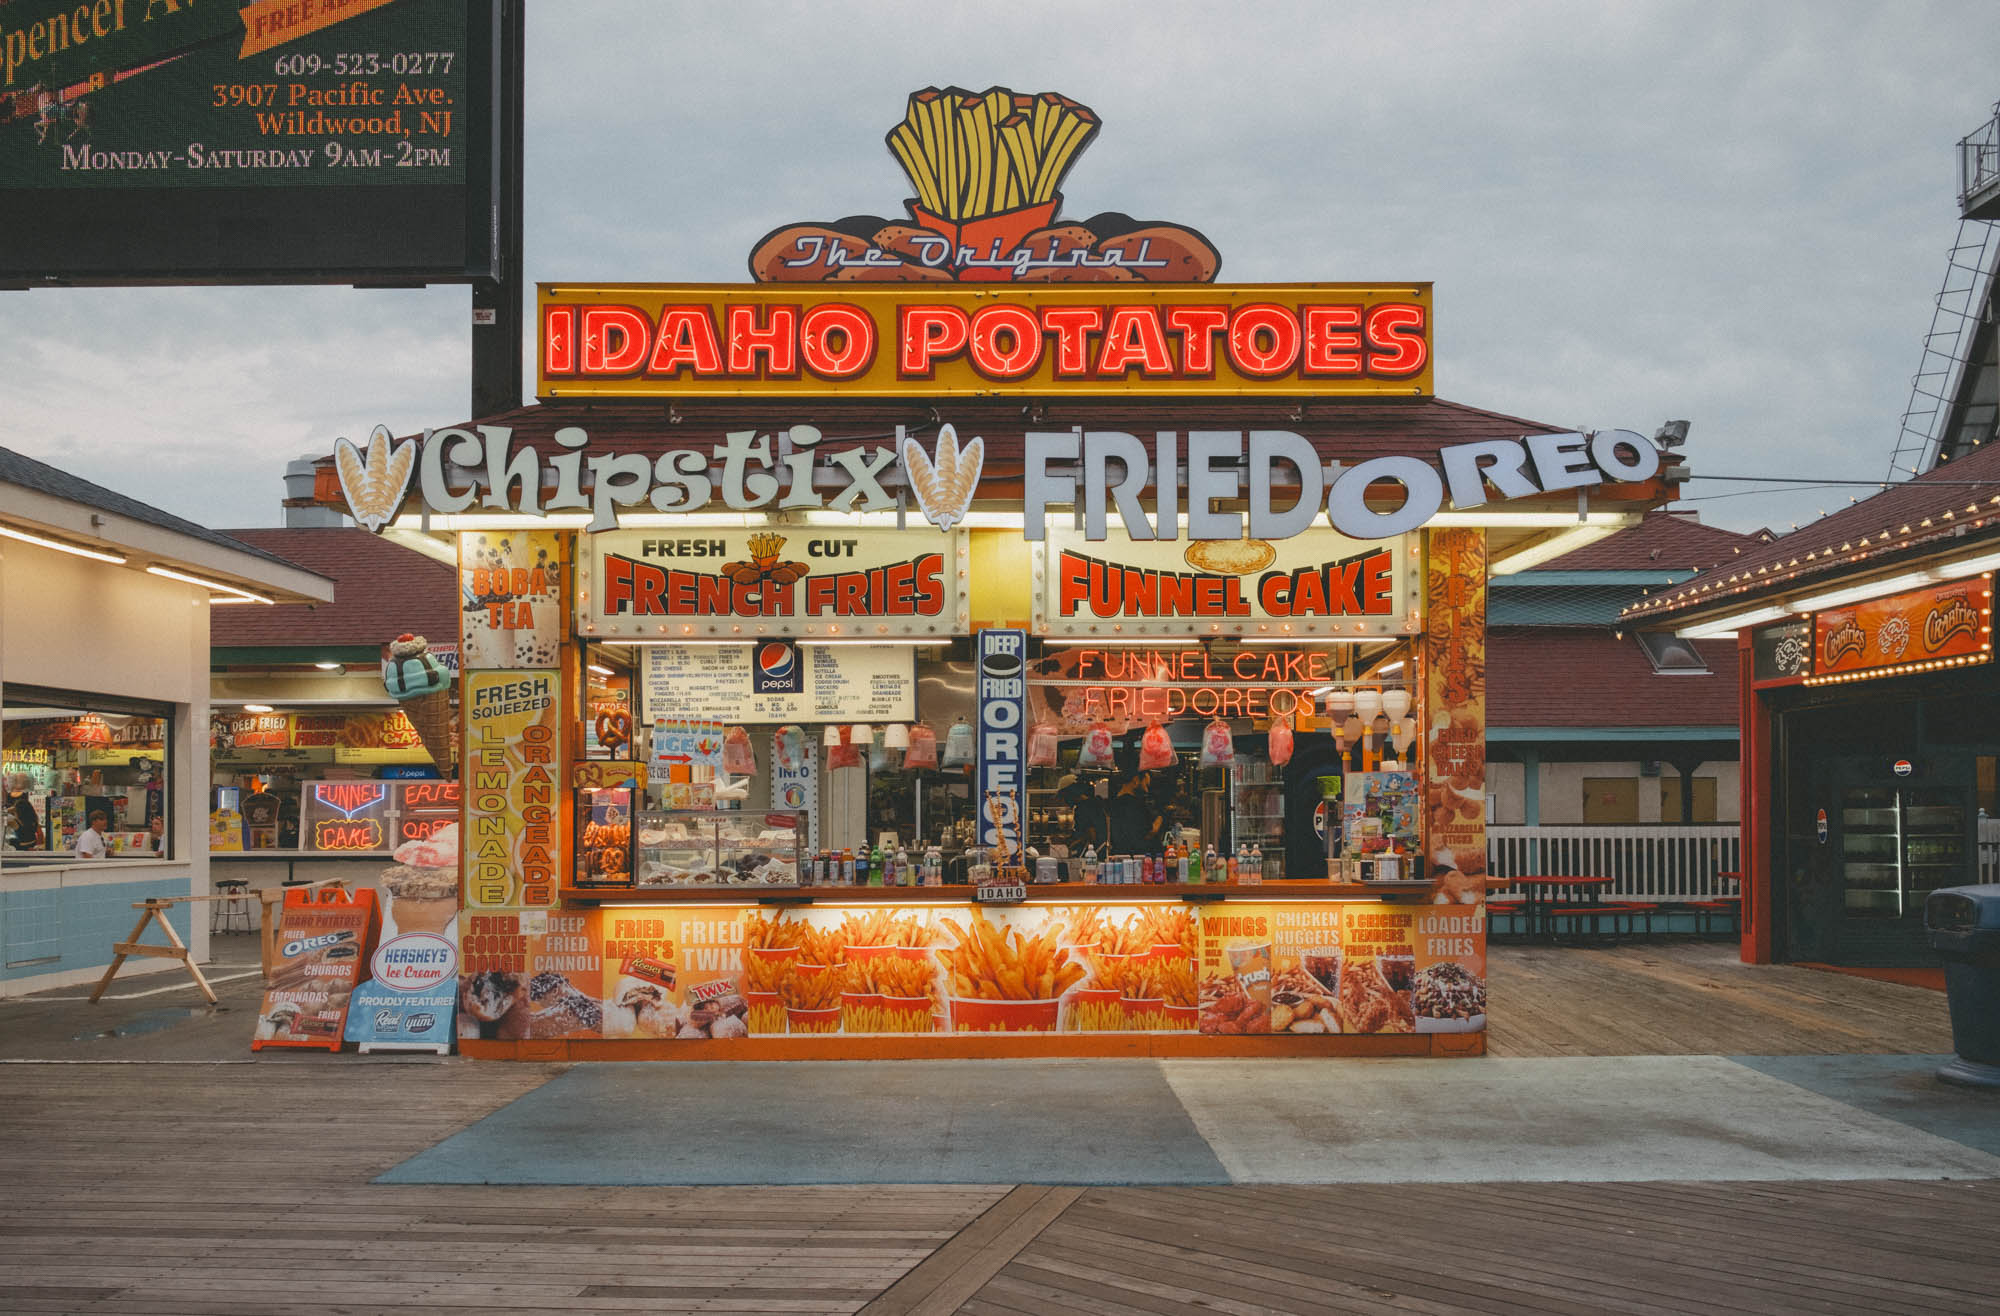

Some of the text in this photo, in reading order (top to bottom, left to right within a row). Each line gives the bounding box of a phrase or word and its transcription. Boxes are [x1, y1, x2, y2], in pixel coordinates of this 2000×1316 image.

[254, 0, 315, 40] FREE
[0, 0, 126, 87] pencer
[275, 52, 455, 76] 609-523-0277
[212, 81, 454, 107] 3907 Pacific Ave.
[256, 110, 453, 137] Wildwood, NJ
[783, 236, 1168, 275] The Original
[544, 303, 1429, 380] IDAHO POTATOES
[420, 424, 900, 533] Chipstix
[1023, 428, 1661, 542] FRIED OREO
[641, 539, 859, 558] FRESH CUT
[473, 568, 548, 597] BOBA
[602, 551, 946, 617] FRENCH FRIES
[1058, 545, 1394, 618] FUNNEL CAKE
[486, 602, 535, 630] TEA
[984, 634, 1020, 655] DEEP
[1079, 650, 1331, 682] FUNNEL CAKE
[475, 677, 550, 706] FRESH
[761, 678, 793, 690] pepsi
[982, 678, 1022, 699] FRIED
[472, 697, 552, 720] SQUEEZED
[232, 717, 287, 732] DEEP FRIED
[655, 718, 724, 736] SHAVED
[655, 736, 695, 752] ICE
[317, 784, 383, 812] FUNNEL
[475, 725, 509, 905] LEMONADE
[521, 724, 553, 906] ORANGEADE
[323, 827, 375, 848] CAKE
[981, 887, 1023, 899] IDAHO
[470, 916, 520, 935] FRIED
[549, 916, 586, 933] DEEP
[614, 919, 665, 938] FRIED
[1202, 916, 1268, 937] WINGS
[1276, 911, 1339, 927] CHICKEN
[1417, 915, 1483, 934] LOADED
[680, 920, 745, 945] FRIED
[1275, 929, 1340, 945] NUGGETS
[283, 933, 339, 957] OREO
[462, 935, 527, 954] COOKIE
[545, 935, 589, 953] FRIED
[1427, 937, 1475, 956] FRIES
[384, 948, 448, 964] HERSHEY'S
[464, 954, 526, 974] DOUGH
[534, 955, 600, 972] CANNOLI
[681, 947, 744, 972] TWIX
[304, 964, 352, 977] CHURROS
[385, 966, 442, 979] Ice Cream
[268, 991, 330, 1004] EMPANADAS
[358, 996, 456, 1007] PROUDLY FEATURED
[692, 980, 734, 1002] TWIX
